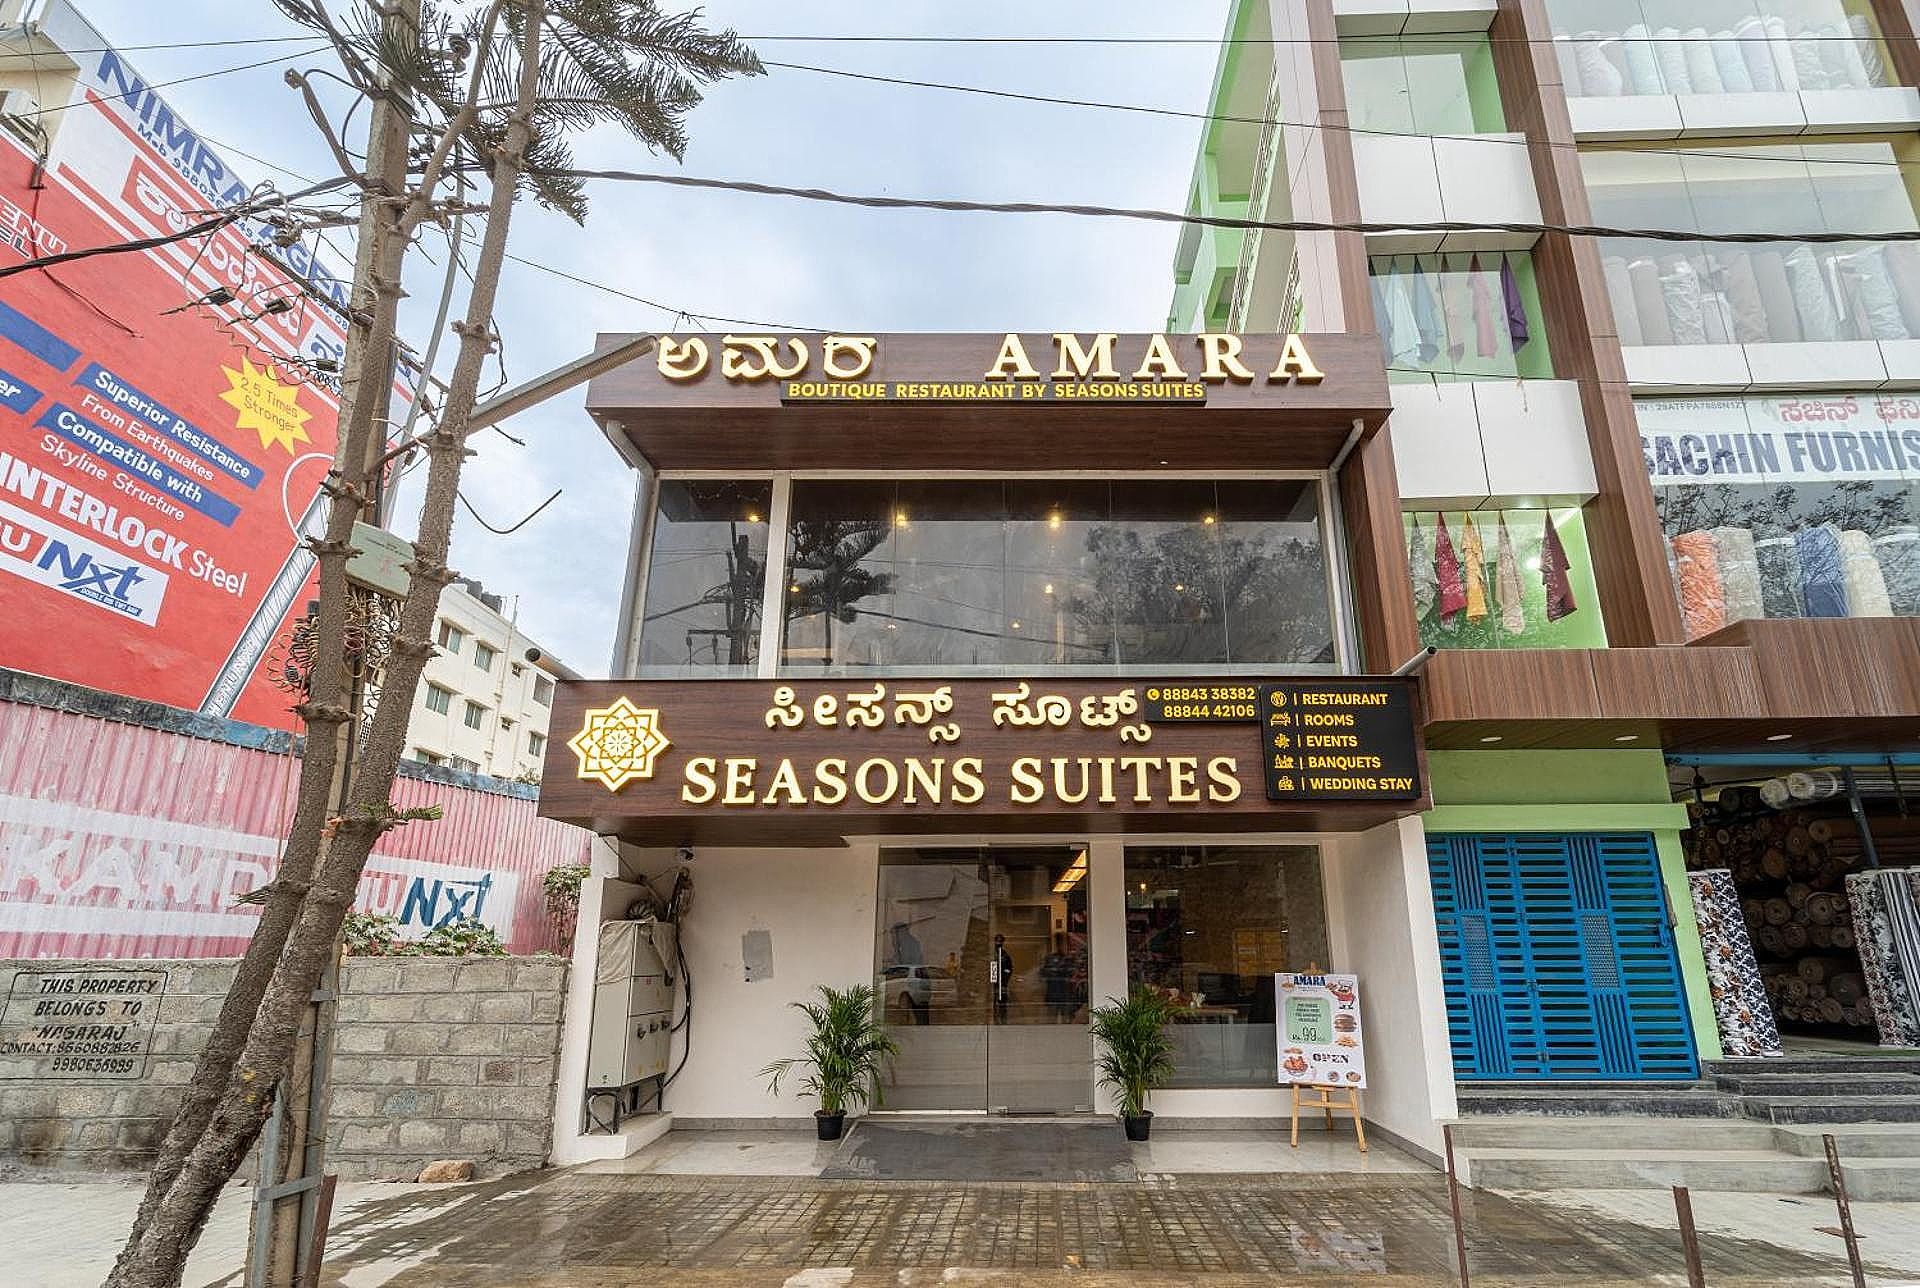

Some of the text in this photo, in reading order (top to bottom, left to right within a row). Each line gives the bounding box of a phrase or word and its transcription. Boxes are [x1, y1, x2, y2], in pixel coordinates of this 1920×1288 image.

[97, 48, 250, 204] NIMRA
[658, 334, 877, 381] ಅಮರ
[985, 333, 1325, 384] AMARA
[266, 389, 299, 419] Times
[788, 383, 1204, 399] BOUTIQUE RESTAURANT BY SEASONS SUITES
[95, 371, 251, 479] Superior Resistance
[243, 395, 296, 432] Stronger
[81, 394, 215, 481] From Earthquakes
[57, 411, 202, 503] Compatible with
[40, 434, 185, 521] Skyline Structure
[0, 453, 248, 598] INTERLOCK Steel
[37, 539, 147, 602] Nxt
[1163, 688, 1256, 701] 88843 38382
[1302, 693, 1388, 706] RESTAURANT
[1163, 705, 1255, 718] 88844 42106
[1304, 714, 1355, 727] ROOMS
[1306, 735, 1358, 748] EVENTS
[1308, 756, 1381, 770] BANQUETS
[682, 756, 1243, 805] SEASONS SUITES
[1310, 777, 1412, 791] WEDDING STAY
[40, 979, 158, 994] THIS PROPERTY
[1293, 975, 1326, 986] AMARA
[35, 1001, 142, 1016] BELONGS TO
